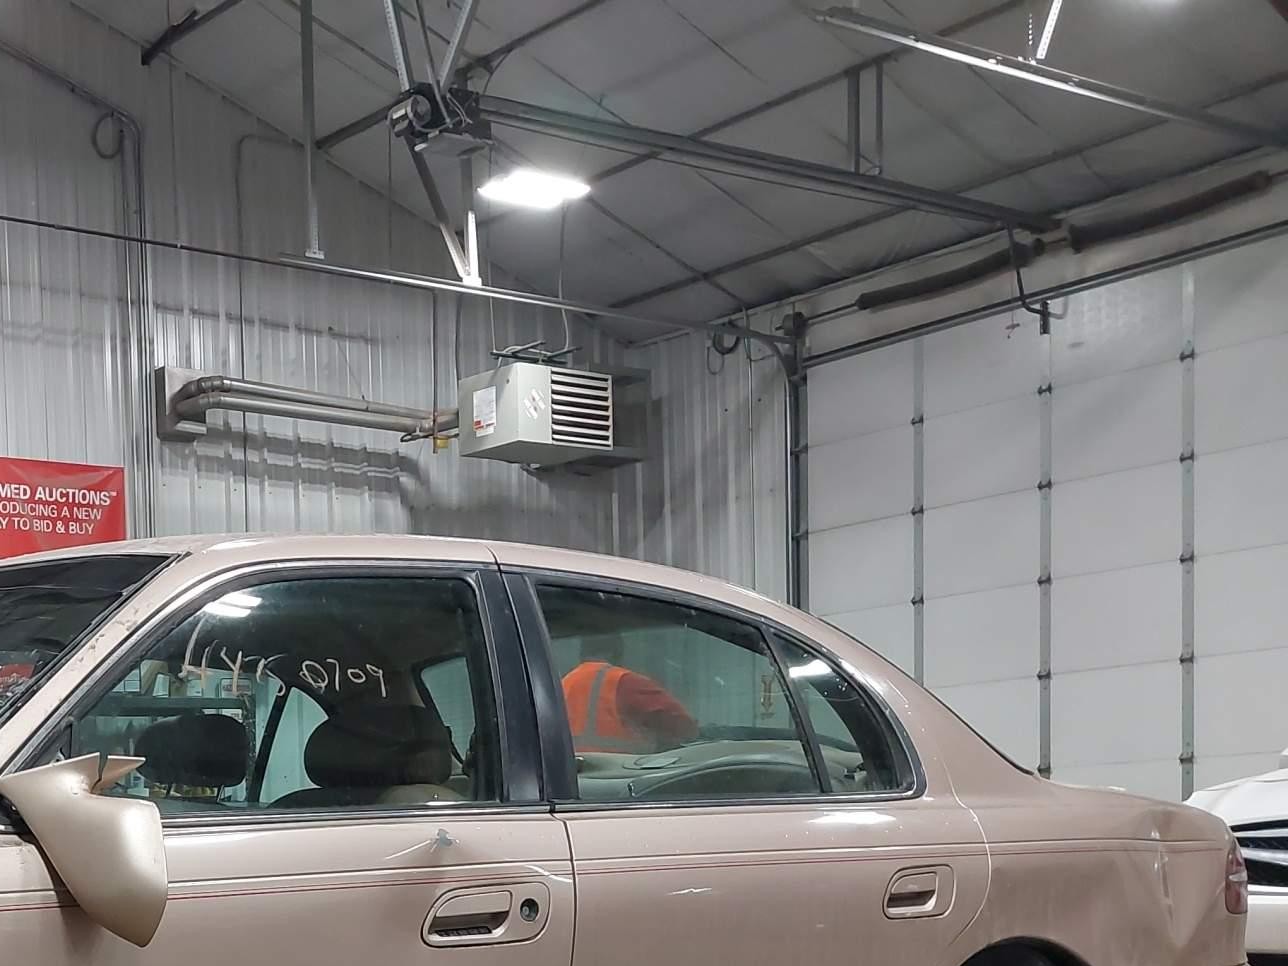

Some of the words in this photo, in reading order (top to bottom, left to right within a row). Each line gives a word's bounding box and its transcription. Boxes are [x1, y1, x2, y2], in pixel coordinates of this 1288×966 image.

[60, 505, 70, 518] A
[73, 507, 102, 520] NEW
[11, 516, 30, 531] TO
[33, 519, 53, 533] BID
[55, 520, 66, 534] &
[69, 521, 95, 535] BUY
